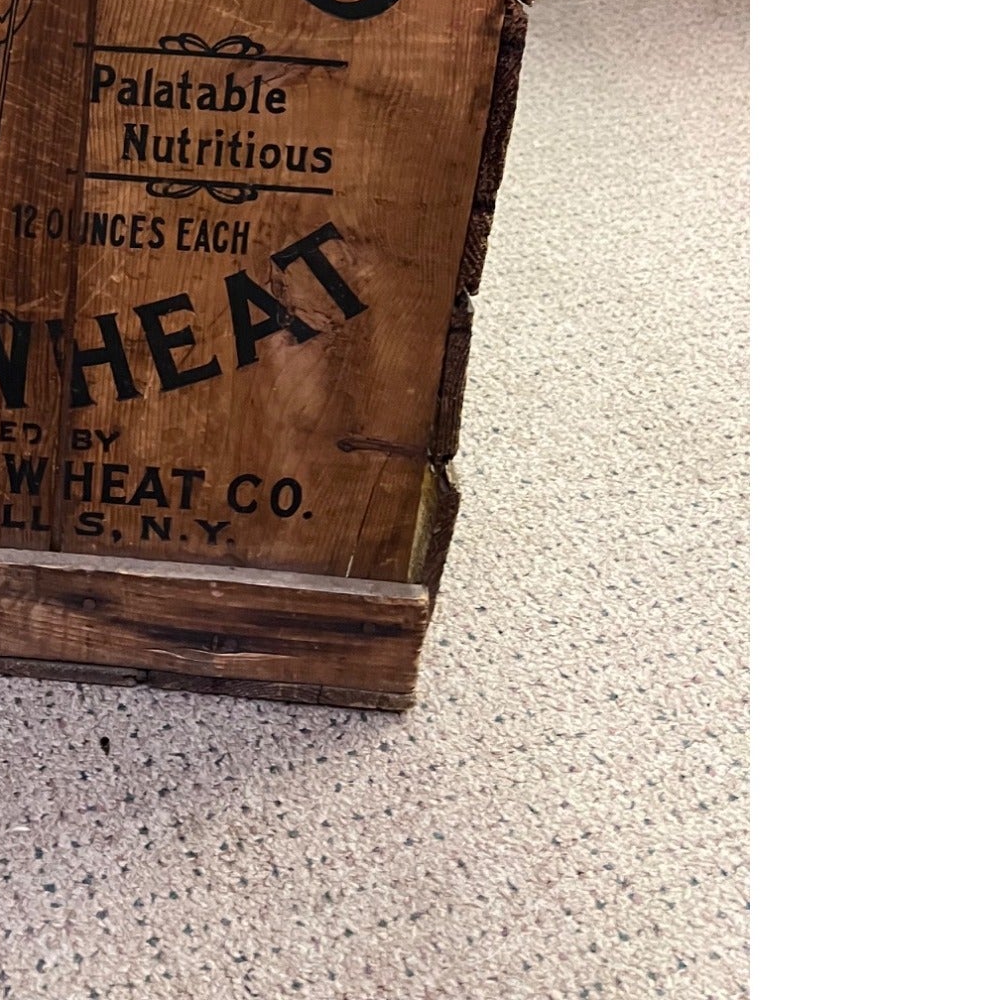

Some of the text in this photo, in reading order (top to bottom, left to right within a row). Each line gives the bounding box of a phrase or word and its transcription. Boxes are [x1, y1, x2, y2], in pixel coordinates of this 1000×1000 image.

[91, 63, 287, 113] Palatable
[121, 123, 333, 173] Nutritious
[12, 204, 37, 240] 12
[177, 217, 250, 255] EACH
[71, 429, 120, 453] BY
[4, 453, 205, 510] WHEAT
[226, 473, 313, 520] CO.
